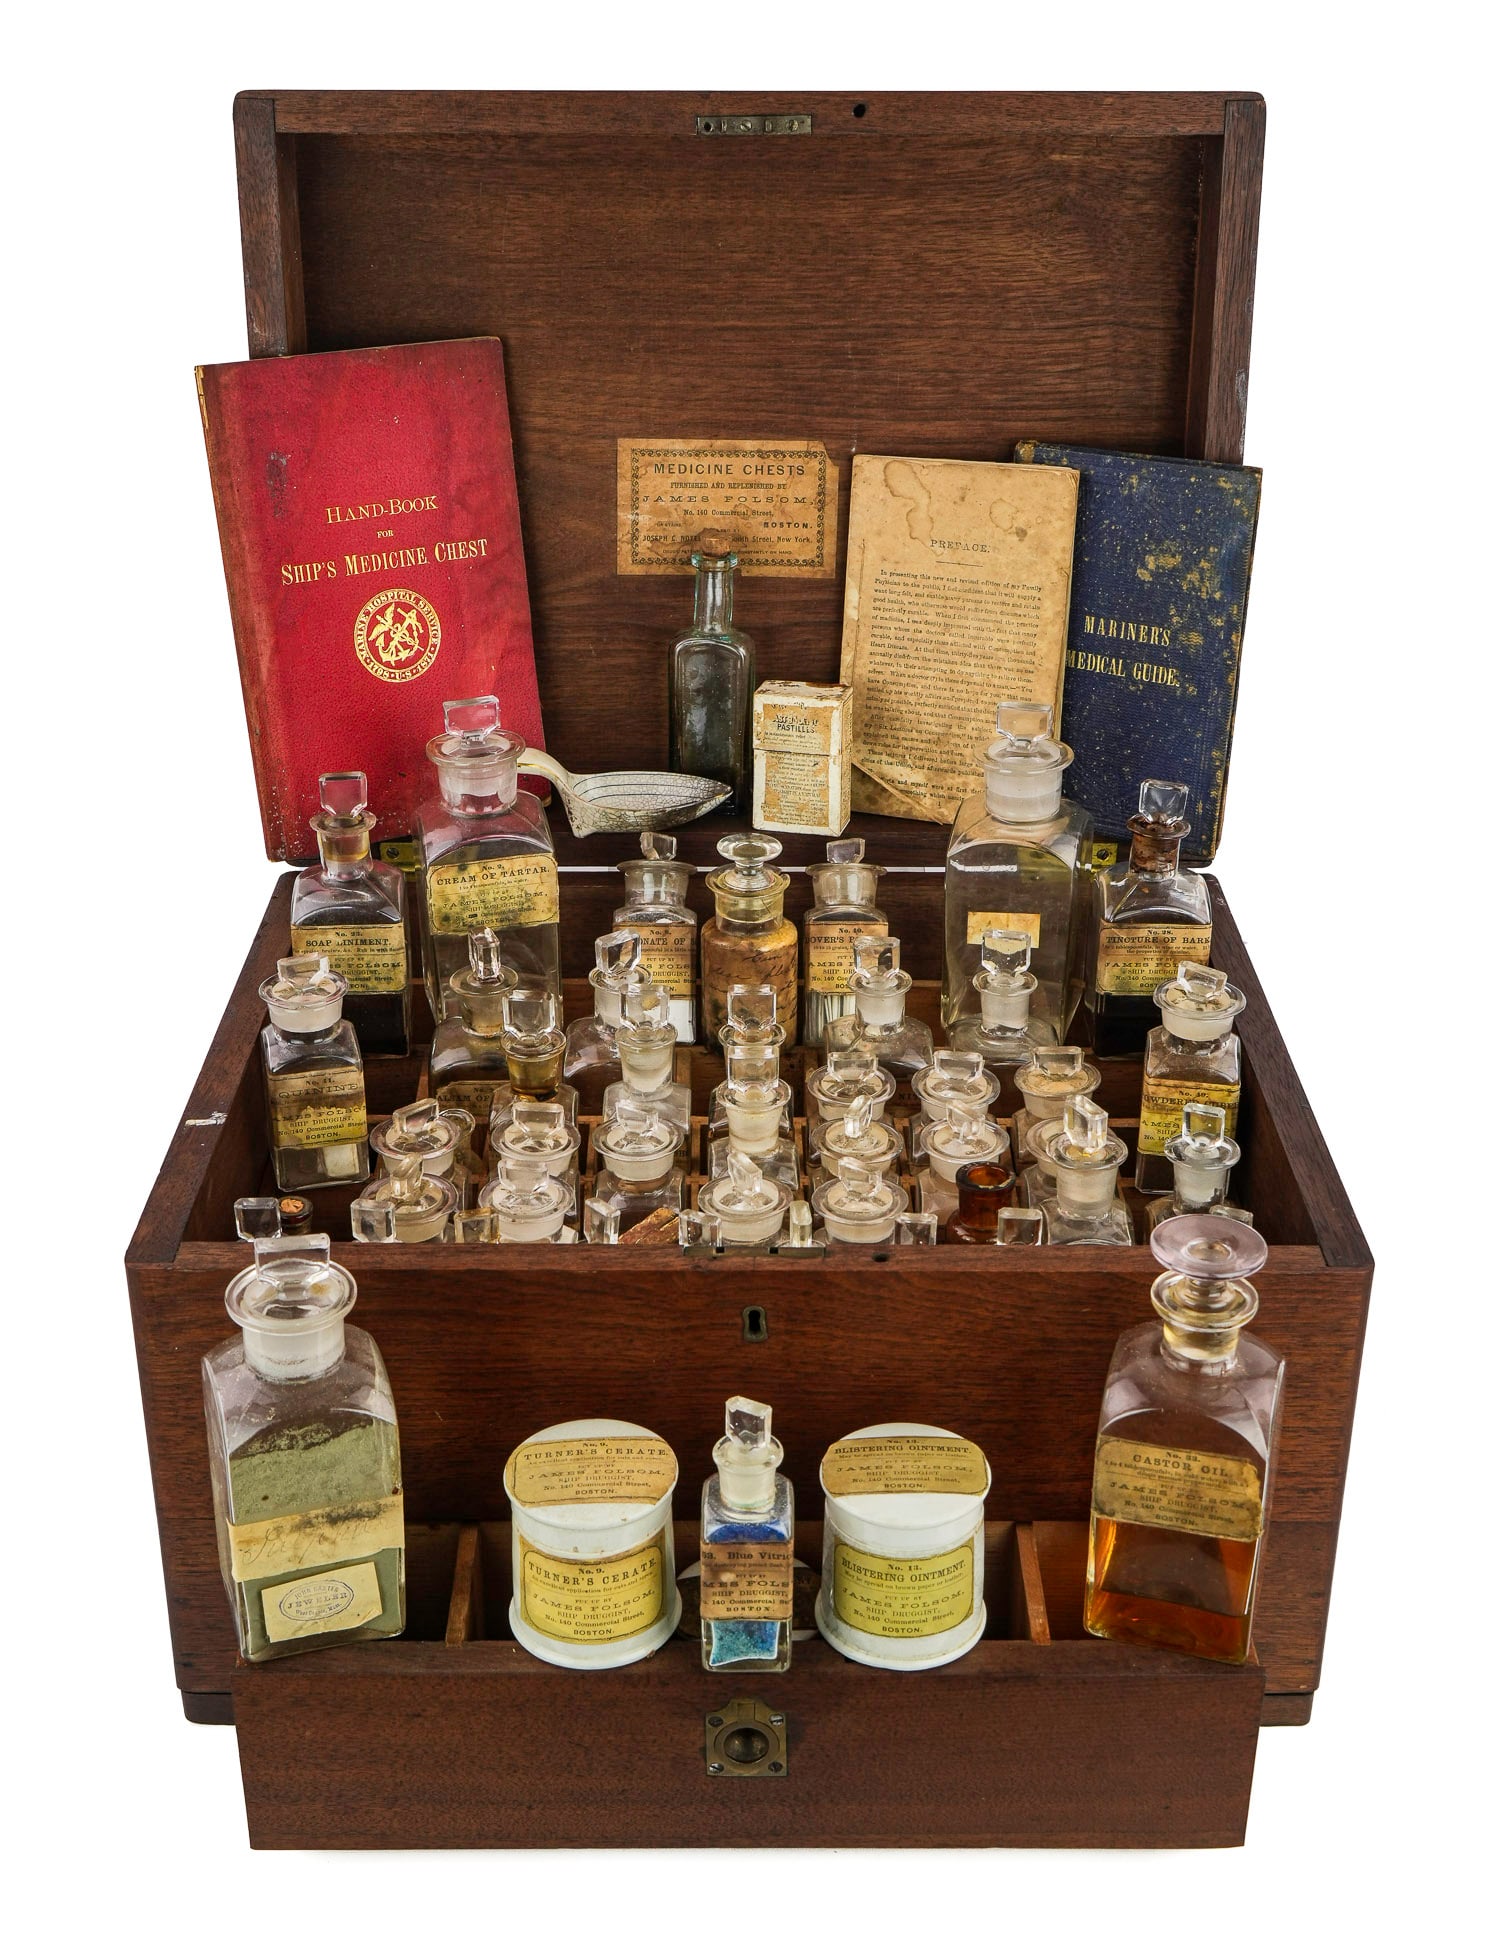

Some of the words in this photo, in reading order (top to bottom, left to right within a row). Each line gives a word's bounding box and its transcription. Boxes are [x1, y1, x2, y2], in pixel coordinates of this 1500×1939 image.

[654, 463, 733, 475] MEDICINE
[743, 464, 805, 476] CHESTS
[724, 496, 814, 505] FOLSOM,
[326, 495, 438, 524] HAND-BOOK
[377, 529, 394, 538] FOR
[281, 560, 337, 586] SHIP'S
[435, 539, 488, 563] CHEST
[368, 592, 415, 612] HOSPITAL
[418, 601, 439, 644] SERVICE
[1085, 615, 1170, 647] MARINER'S
[437, 875, 476, 886] CREAM
[501, 866, 549, 878] TARTAR.
[279, 1084, 358, 1098] QUININE
[306, 1132, 340, 1140] BOSTON.
[524, 1449, 597, 1460] TURNER'S
[835, 1445, 903, 1454] BLISTERING
[909, 1445, 972, 1454] OINTMENT.
[1133, 1454, 1192, 1471] CASTOR
[529, 1470, 586, 1479] JAMES
[1109, 1481, 1168, 1497] JAMES
[528, 1561, 594, 1585] TURNER'S
[841, 1557, 905, 1583] BLISTERING
[910, 1560, 966, 1583] OINTMENT.
[533, 1593, 583, 1612] JAMES
[841, 1588, 892, 1608] JAMES
